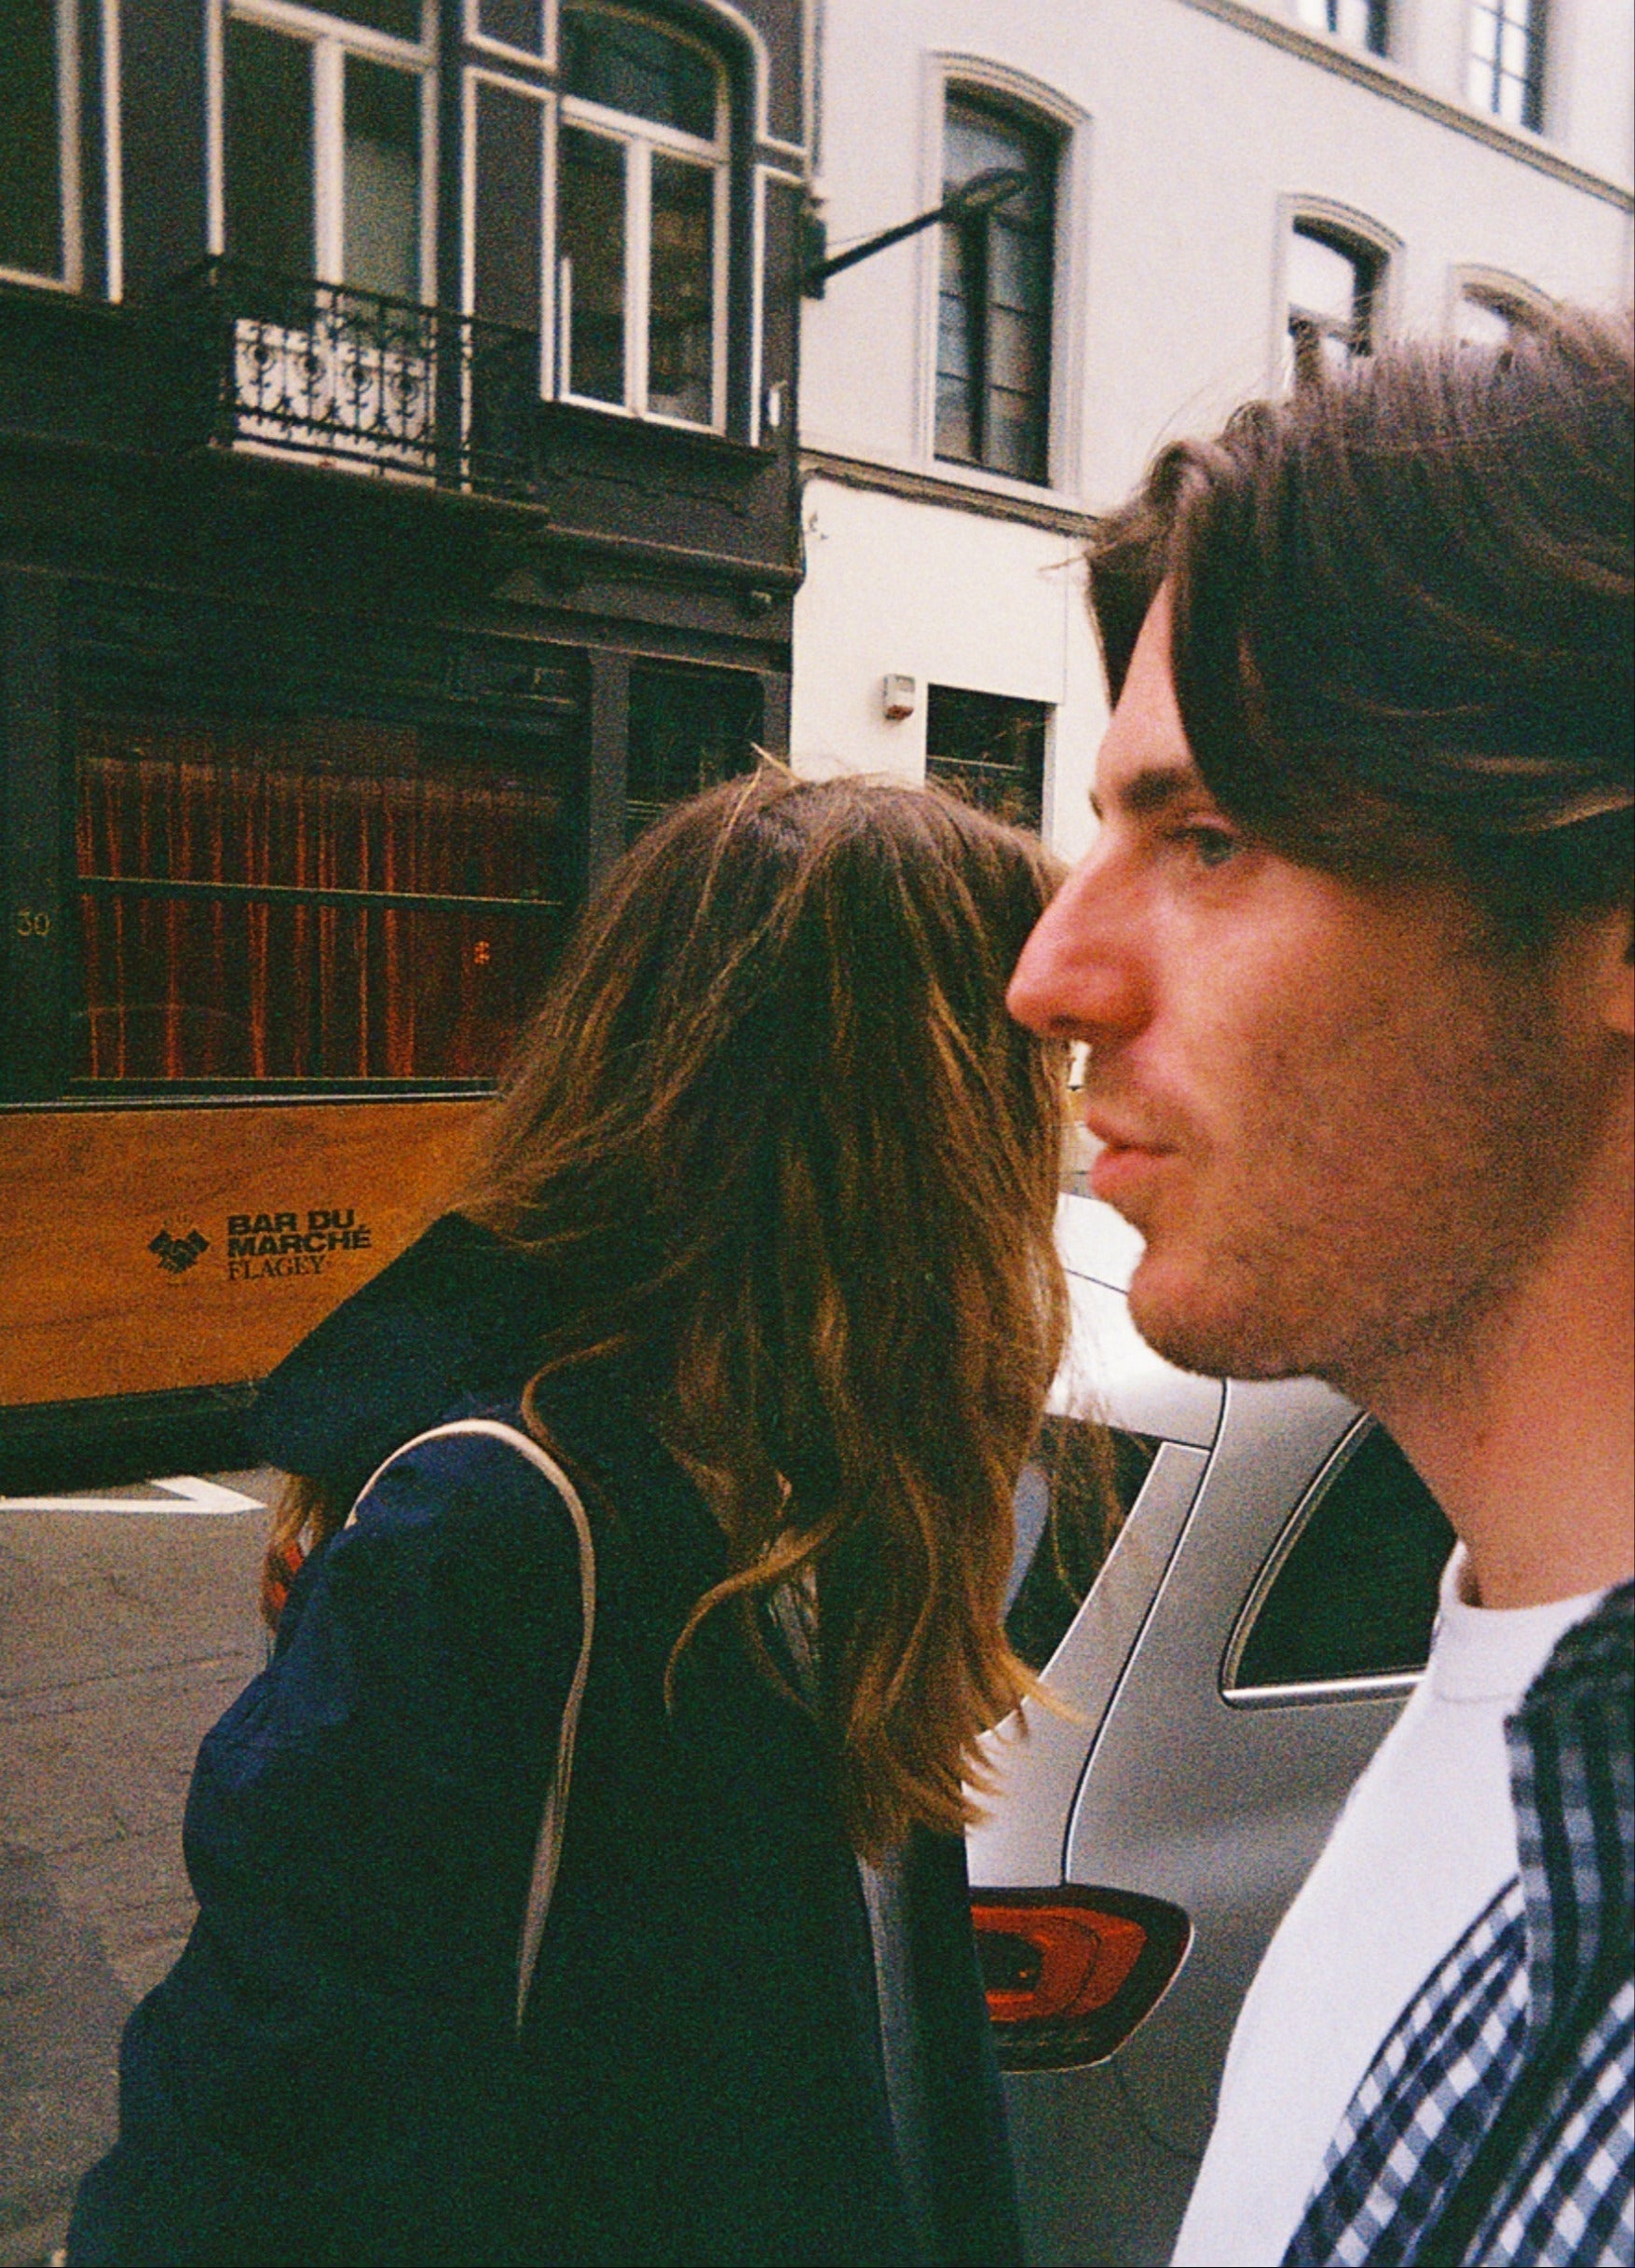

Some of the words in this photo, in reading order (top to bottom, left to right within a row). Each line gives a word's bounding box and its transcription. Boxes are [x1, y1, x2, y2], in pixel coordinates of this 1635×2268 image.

[17, 909, 50, 936] 30
[228, 1212, 297, 1236] BAR
[307, 1209, 355, 1230] DU
[228, 1224, 372, 1258] MARCHÉ
[228, 1255, 325, 1280] FLAGEY
